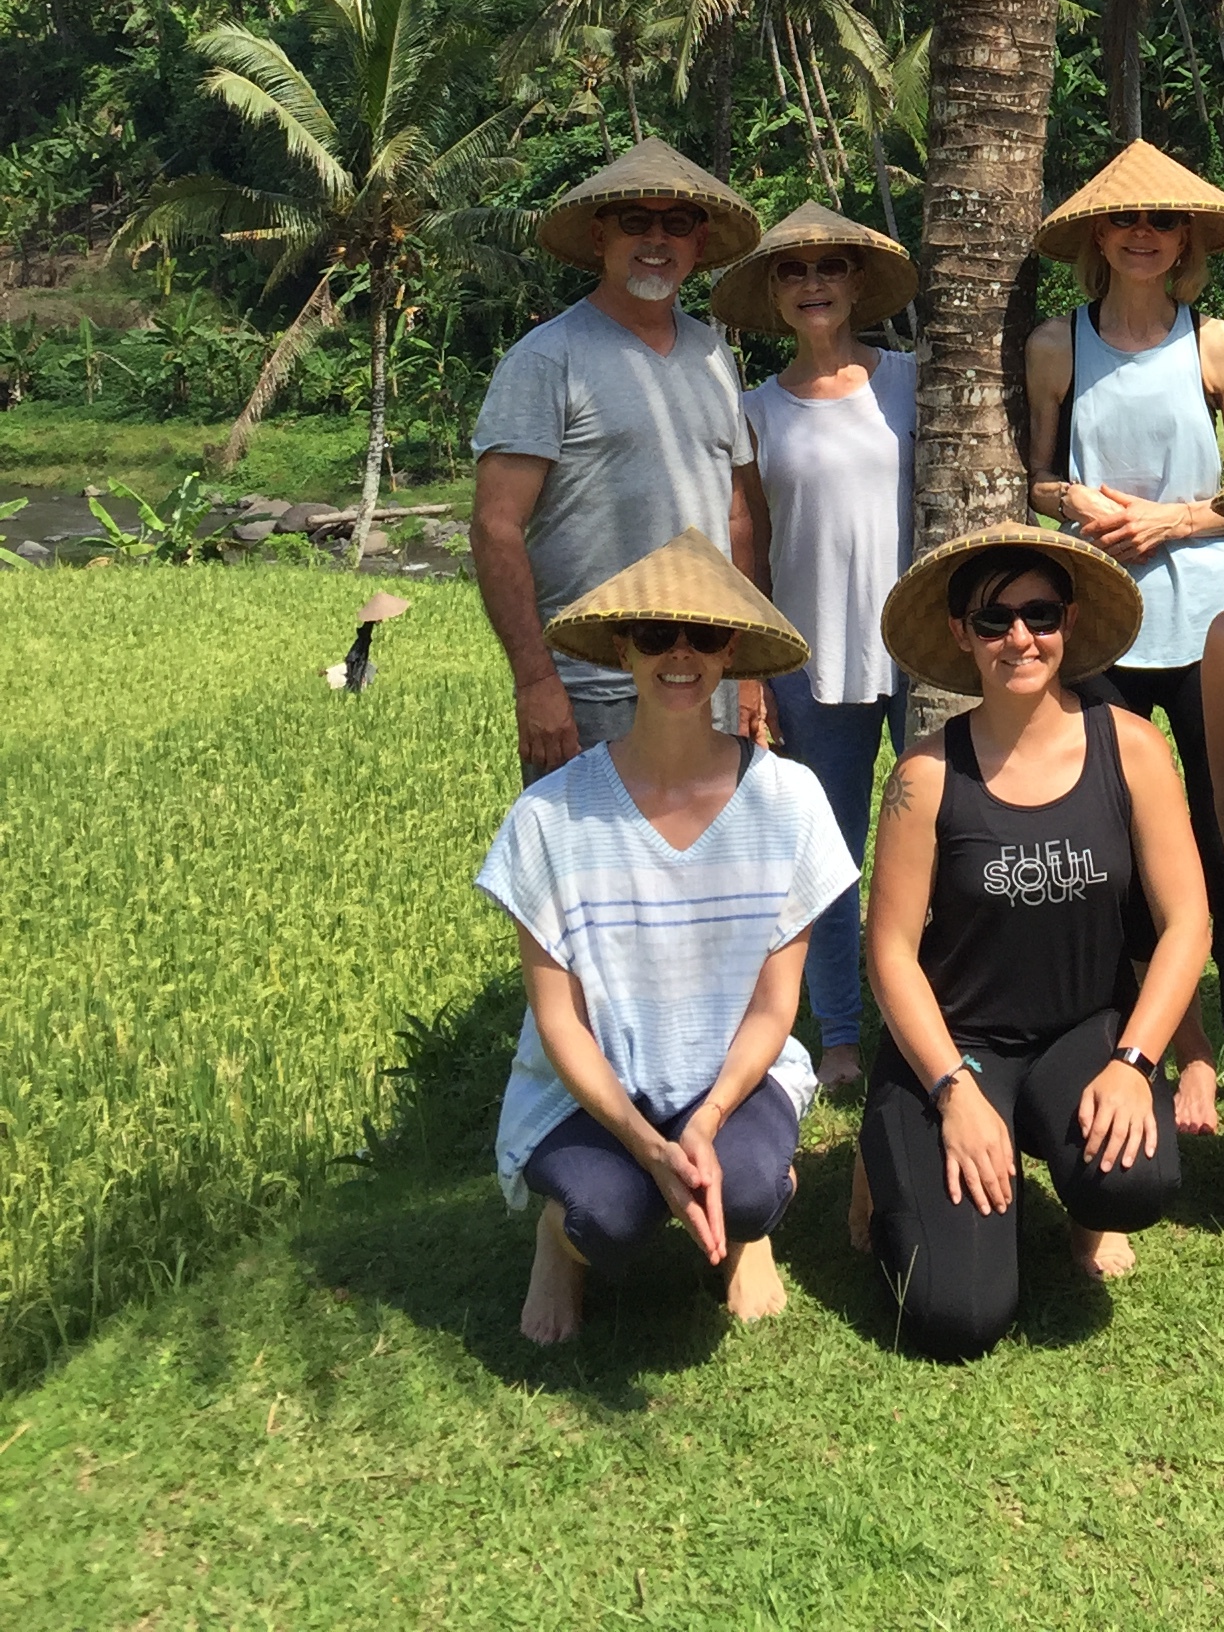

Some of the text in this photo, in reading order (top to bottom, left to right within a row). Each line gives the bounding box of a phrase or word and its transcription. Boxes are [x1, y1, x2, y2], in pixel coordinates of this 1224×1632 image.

[1001, 838, 1084, 869] FUEL
[983, 849, 1107, 895] SOUL
[1003, 878, 1087, 908] YOUR
